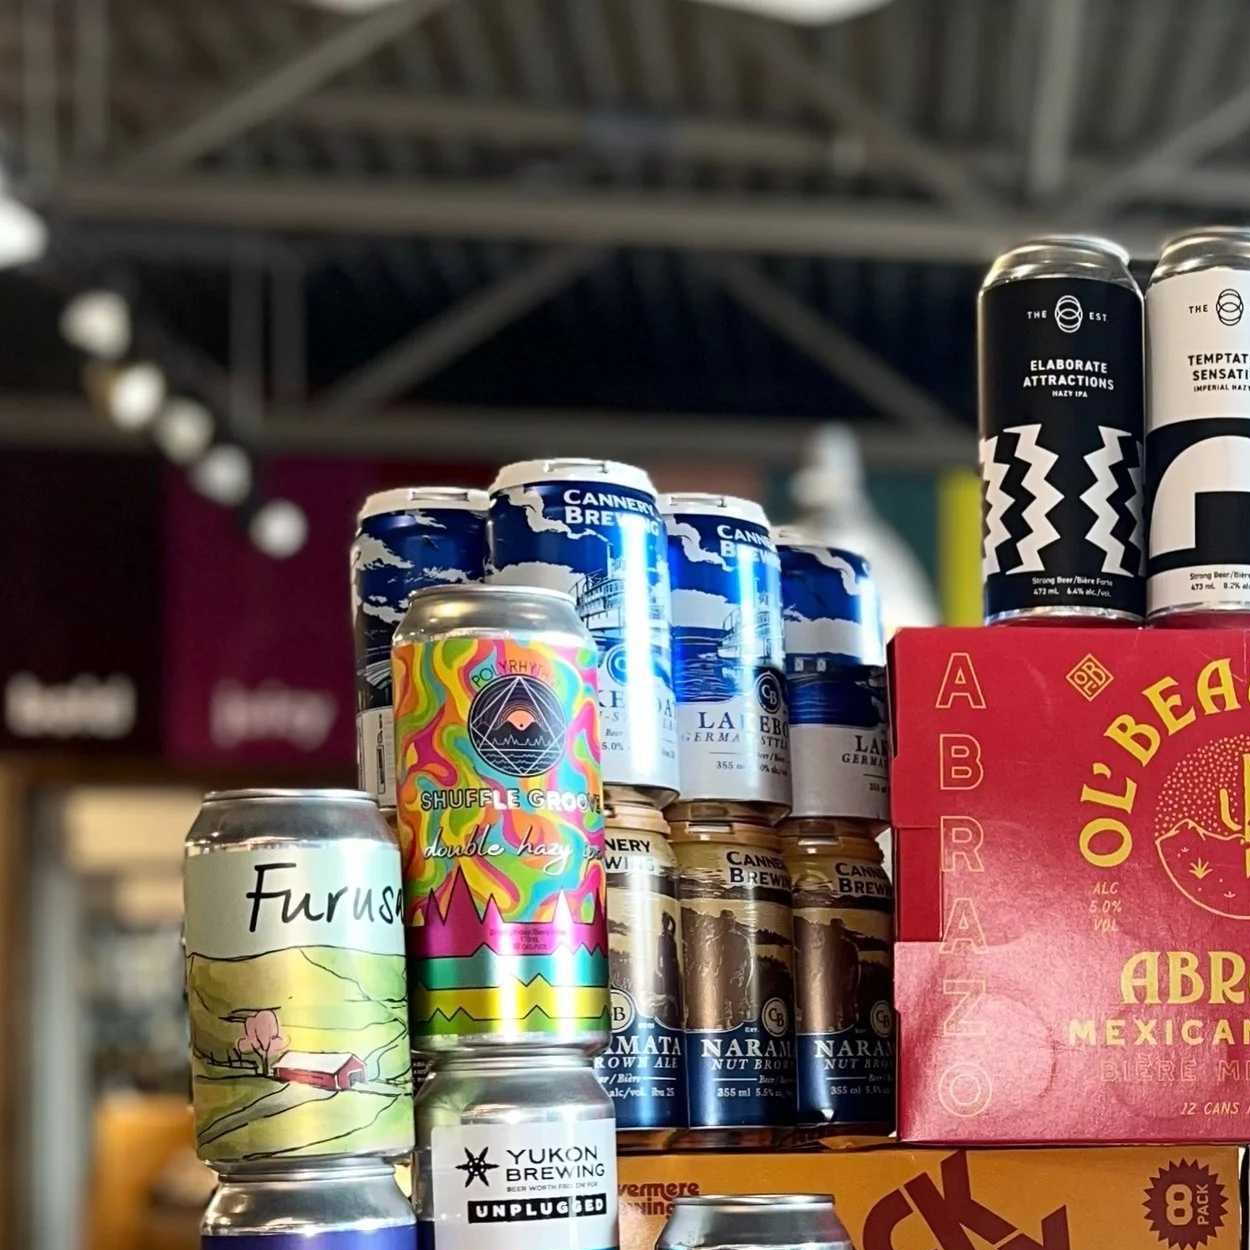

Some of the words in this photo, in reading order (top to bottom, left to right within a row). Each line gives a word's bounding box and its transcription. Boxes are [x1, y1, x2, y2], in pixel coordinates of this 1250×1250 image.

[1027, 311, 1048, 320] THE
[1189, 304, 1209, 314] THE
[1030, 360, 1108, 374] ELABORATE
[1022, 374, 1115, 390] ATTRACTIONS
[1193, 384, 1229, 393] IMPERIAL
[1052, 389, 1073, 398] HAZY
[1074, 390, 1088, 399] IPA
[421, 789, 520, 812] SHUFFLE
[424, 824, 503, 860] double
[516, 827, 573, 875] hazy
[935, 652, 992, 1118] ABRAZO
[1092, 882, 1119, 895] ALC
[1089, 900, 1122, 914] 5.0%
[1092, 919, 1118, 932] VOL
[655, 1057, 678, 1069] ALE
[711, 1057, 746, 1070] NUT
[717, 1088, 736, 1097] 355
[1204, 1101, 1239, 1115] CANS
[506, 1146, 598, 1165] YUKON
[506, 1161, 606, 1182] BREWING
[475, 1198, 604, 1218] UNPLUGGED
[1165, 1183, 1194, 1226] 8
[1198, 1183, 1210, 1226] PACK
